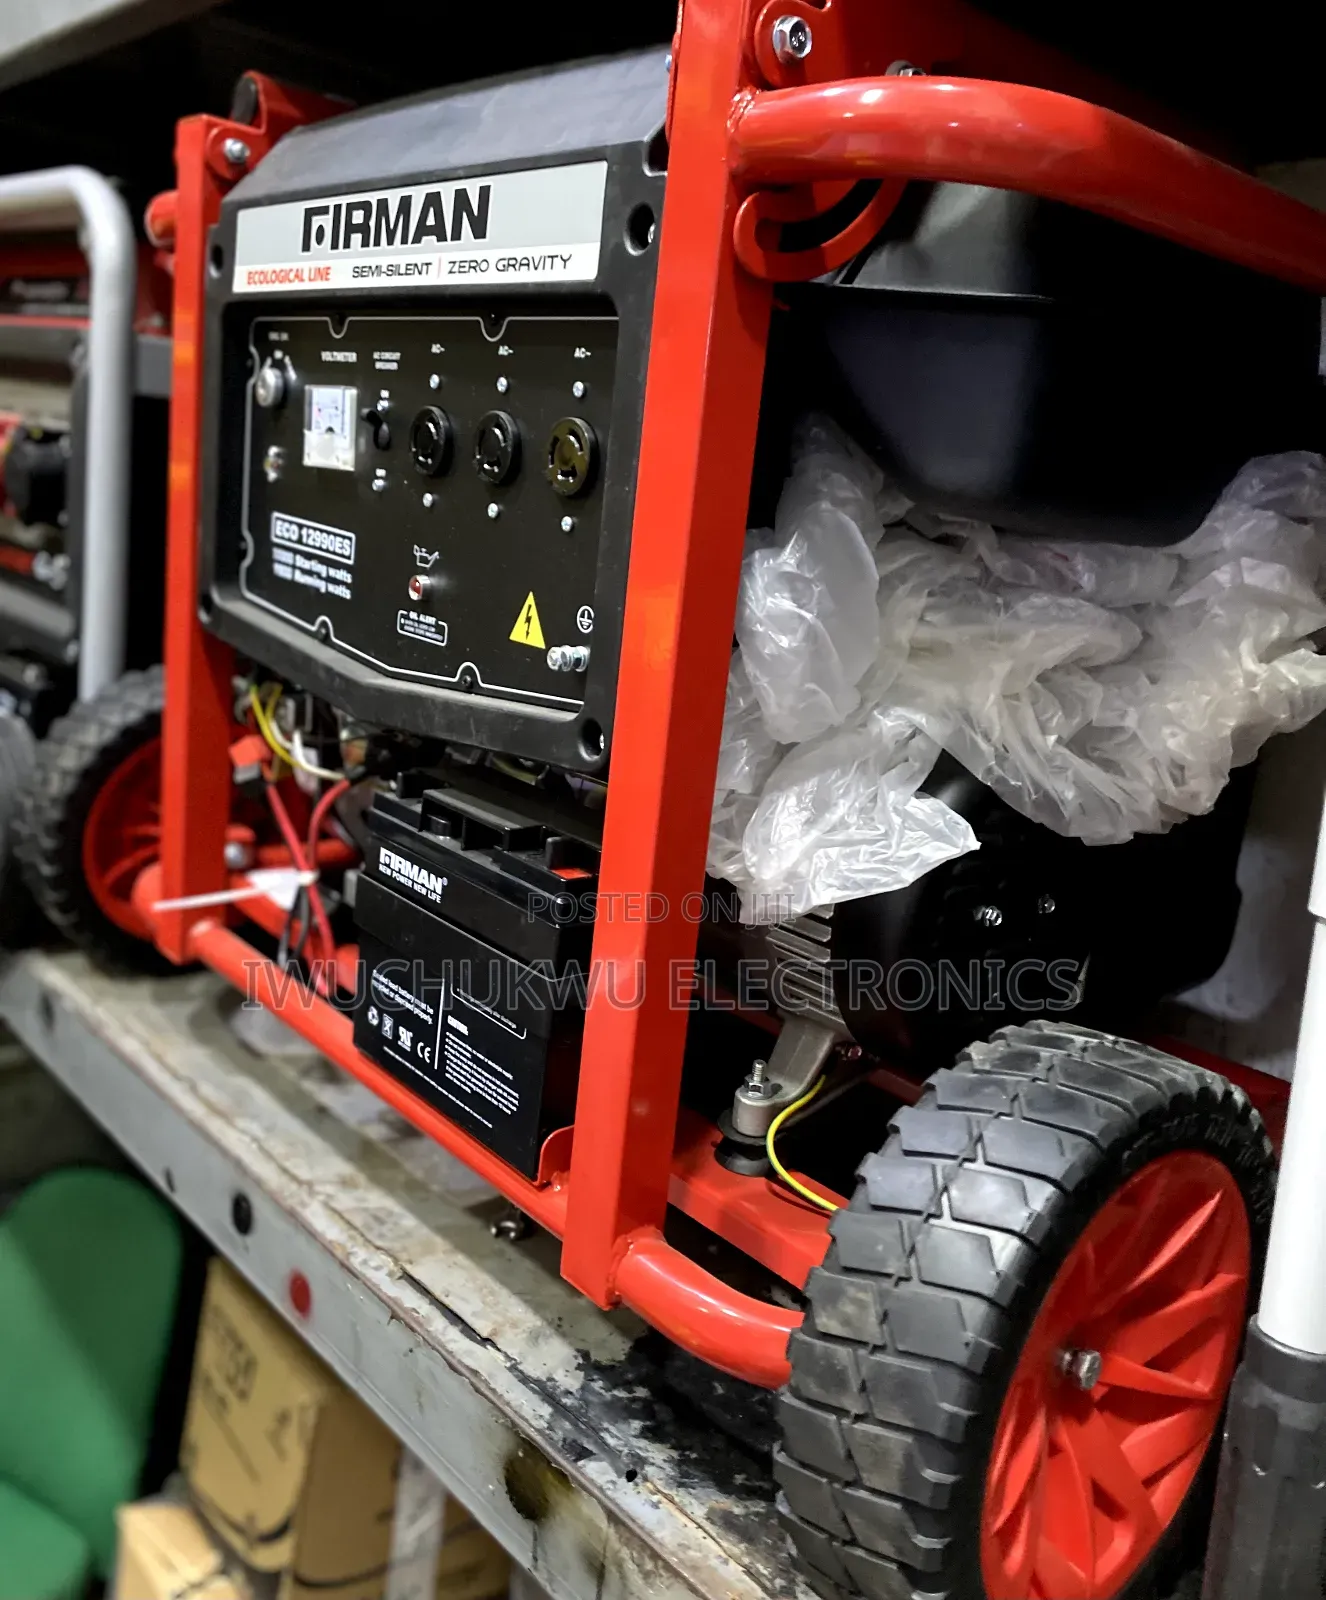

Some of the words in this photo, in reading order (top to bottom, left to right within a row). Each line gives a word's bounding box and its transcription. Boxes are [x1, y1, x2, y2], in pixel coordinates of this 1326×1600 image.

[302, 185, 491, 253] FIRMAN
[352, 262, 432, 279] SEMI-SILENT
[448, 259, 489, 275] ZERO
[495, 254, 572, 272] GRAVITY
[247, 267, 305, 286] ECOLOGICAL
[308, 266, 331, 282] LINE
[275, 520, 299, 541] ECO
[301, 527, 351, 556] 12990ES
[328, 566, 353, 583] watts
[327, 582, 352, 600] watts
[379, 863, 392, 876] NEW
[392, 870, 413, 888] POWER
[413, 881, 427, 896] NEW
[428, 890, 441, 904] LIFE
